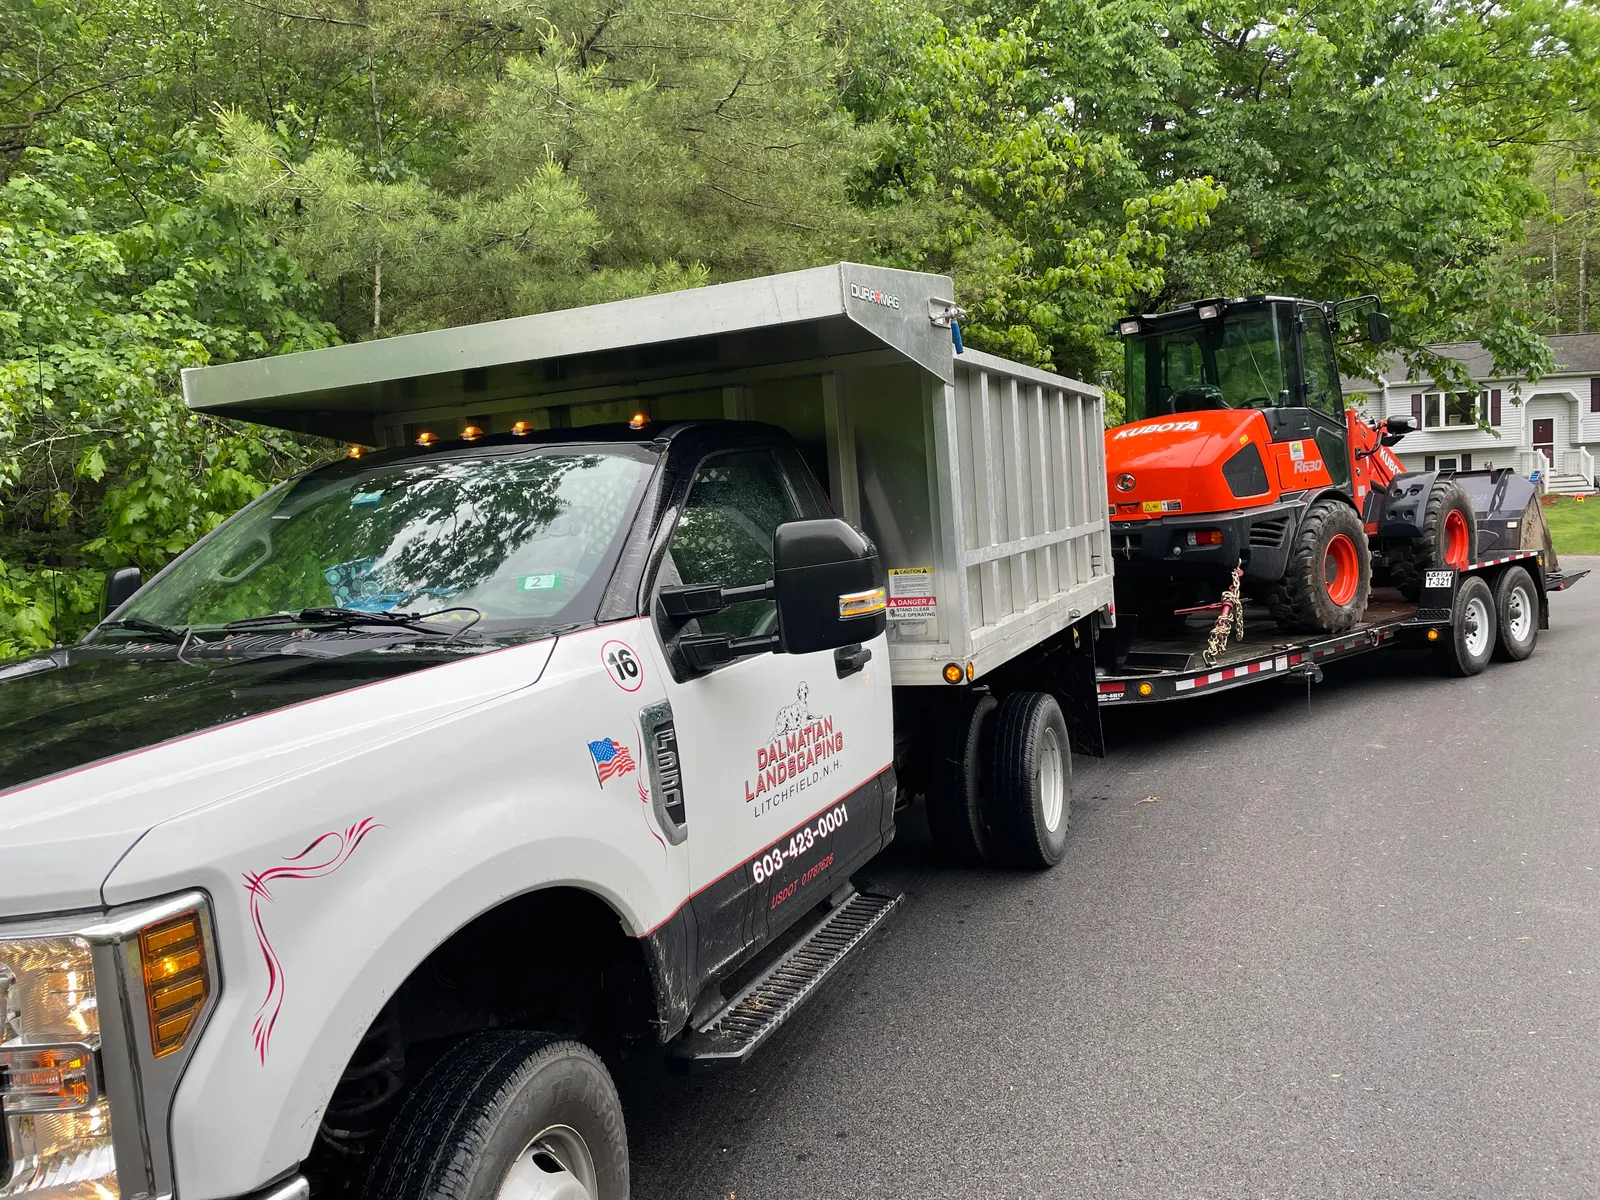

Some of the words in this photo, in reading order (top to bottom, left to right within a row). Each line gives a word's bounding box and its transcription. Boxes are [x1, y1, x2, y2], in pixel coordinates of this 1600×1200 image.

[1113, 420, 1200, 440] KUBOTA
[1294, 459, 1323, 475] R630
[1380, 447, 1402, 475] KUBO
[530, 576, 542, 588] 2
[1428, 577, 1450, 587] T-321
[607, 649, 639, 681] 16
[757, 714, 834, 772] DALMATIAN
[654, 728, 683, 808] F350
[744, 731, 844, 803] LANDSCAPING
[752, 803, 849, 884] 603-423-0001
[771, 879, 799, 910] USDOT
